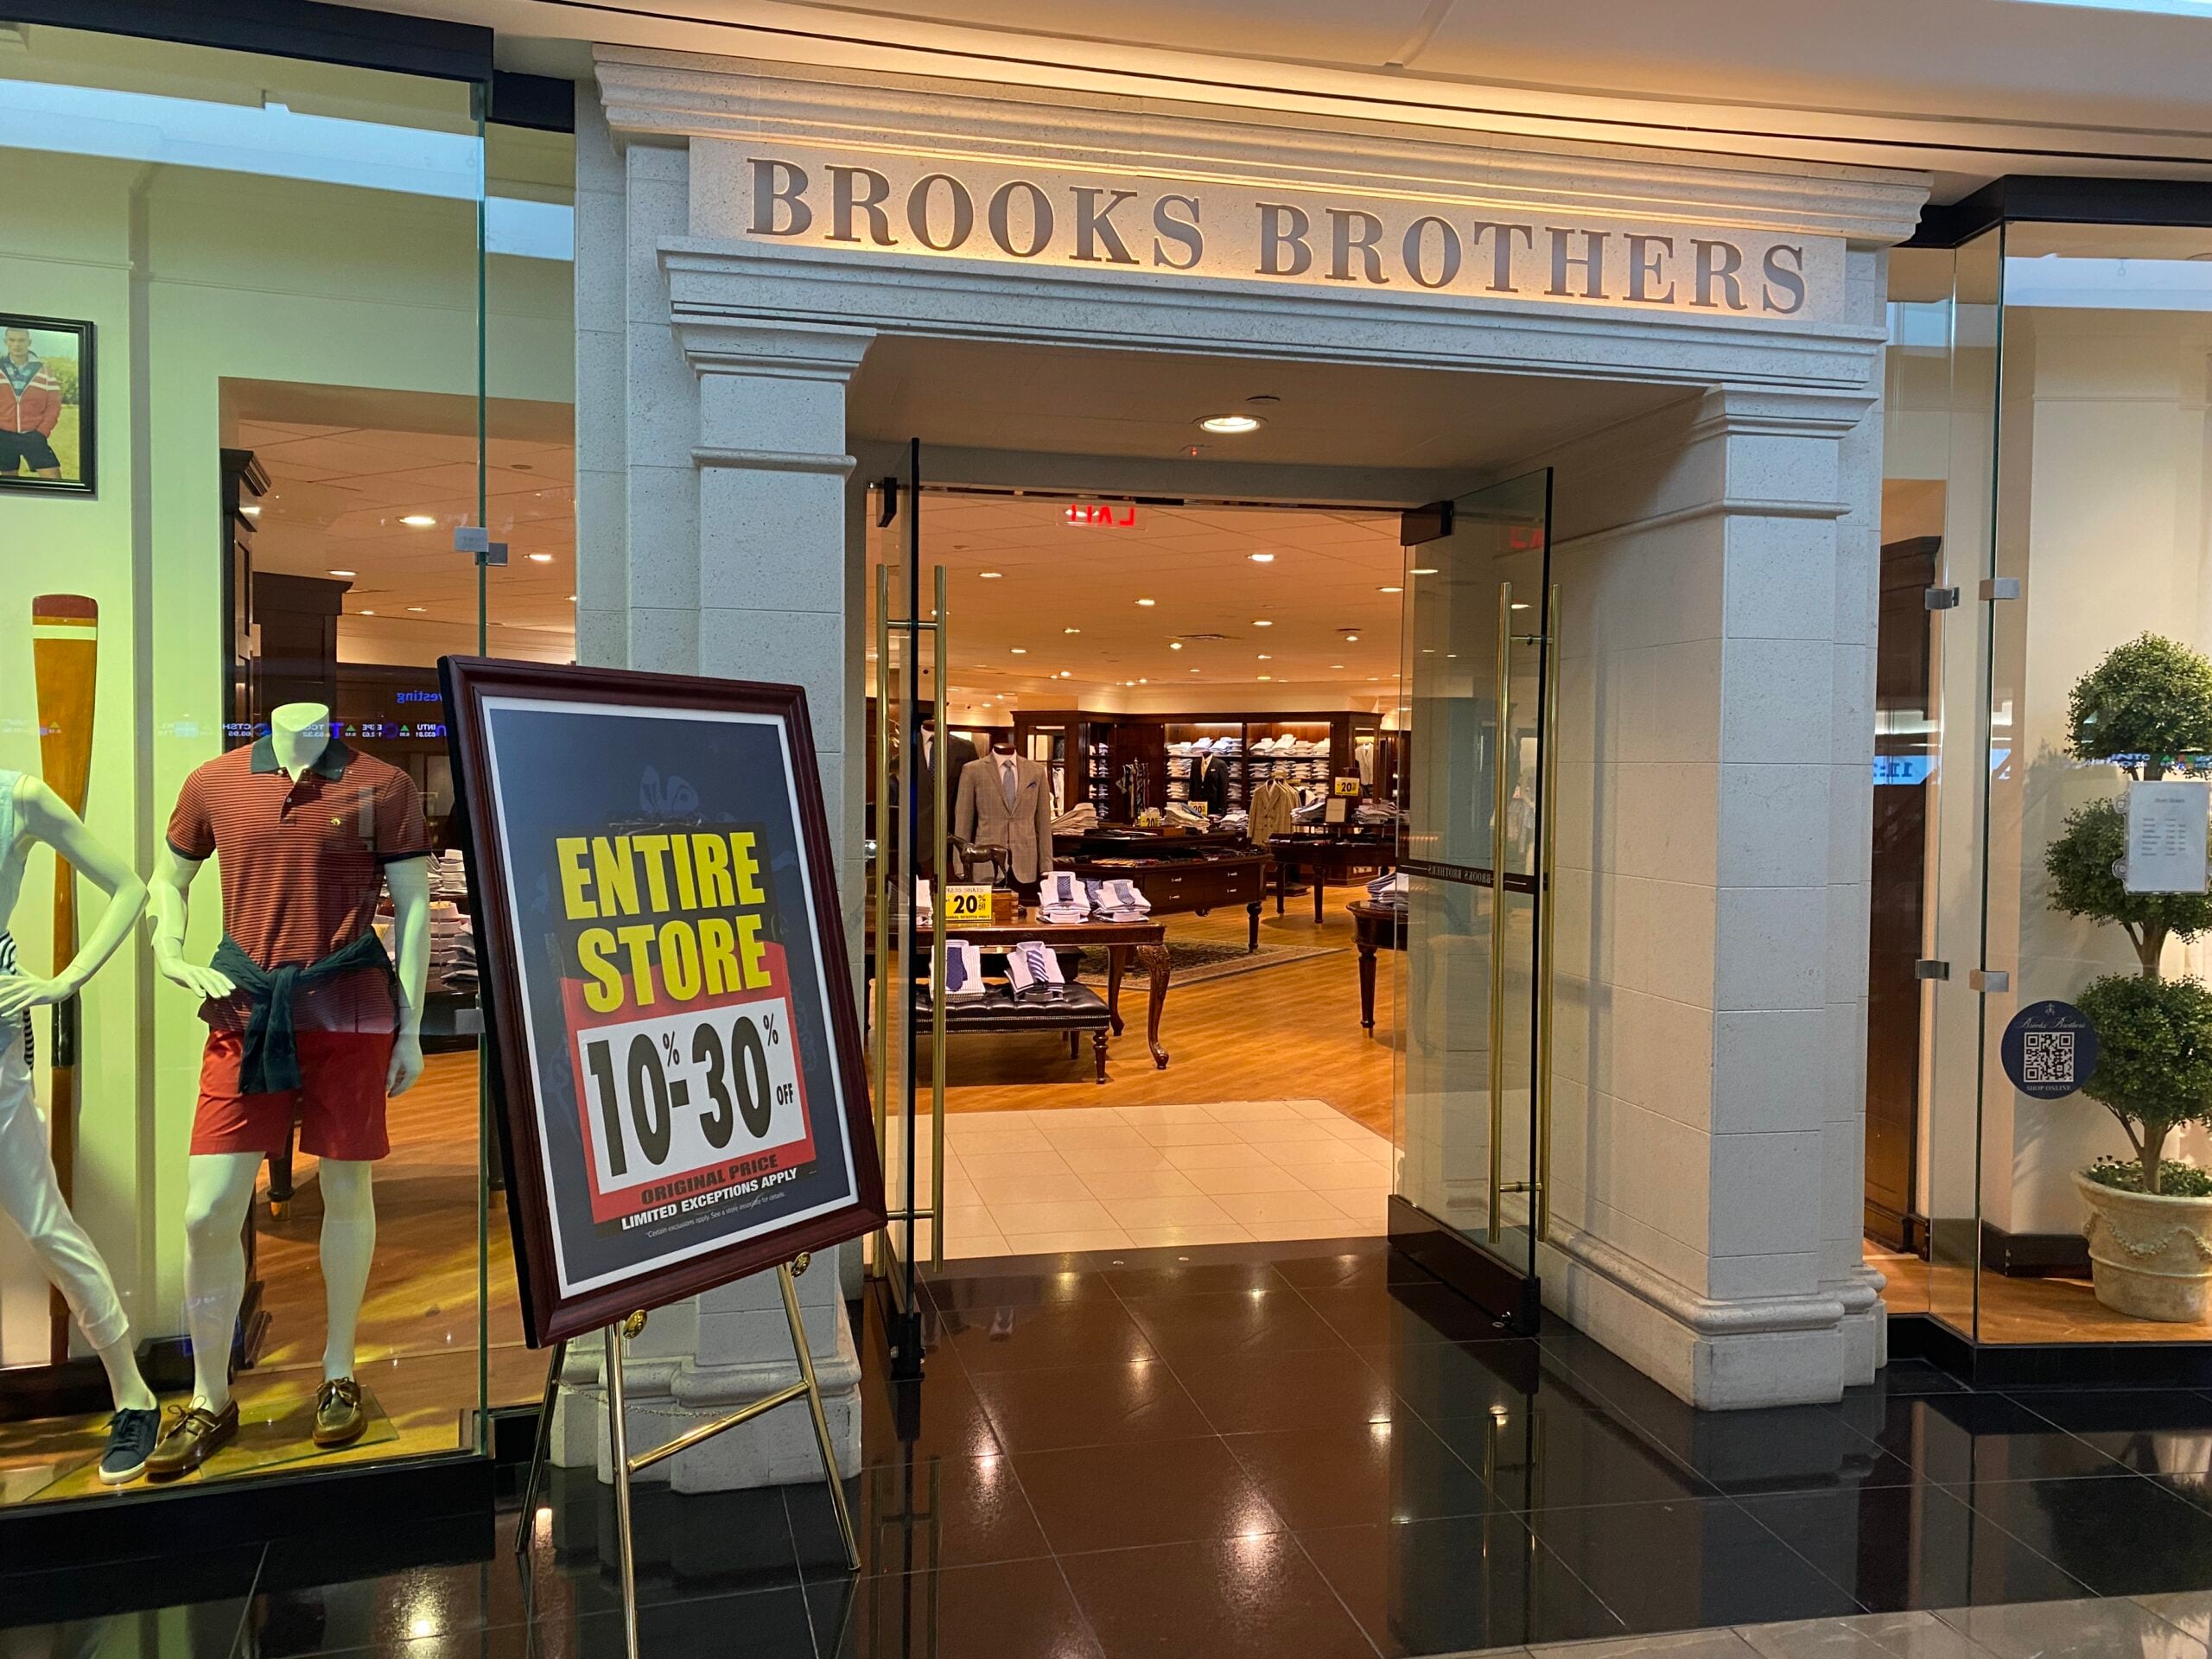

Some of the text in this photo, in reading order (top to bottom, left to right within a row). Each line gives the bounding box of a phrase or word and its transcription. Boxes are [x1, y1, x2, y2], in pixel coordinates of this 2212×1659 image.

[746, 156, 1807, 315] BROOKS BROTHERS
[556, 831, 766, 920] ENTIRE
[577, 913, 772, 1014] STORE
[777, 1083, 794, 1106] OFF
[621, 1167, 798, 1230] LIMITED EXCEPTIONS APPLY
[641, 1154, 779, 1205] ORIGINAL PRICE
[668, 1219, 695, 1232] exclusions
[710, 1210, 721, 1219] See
